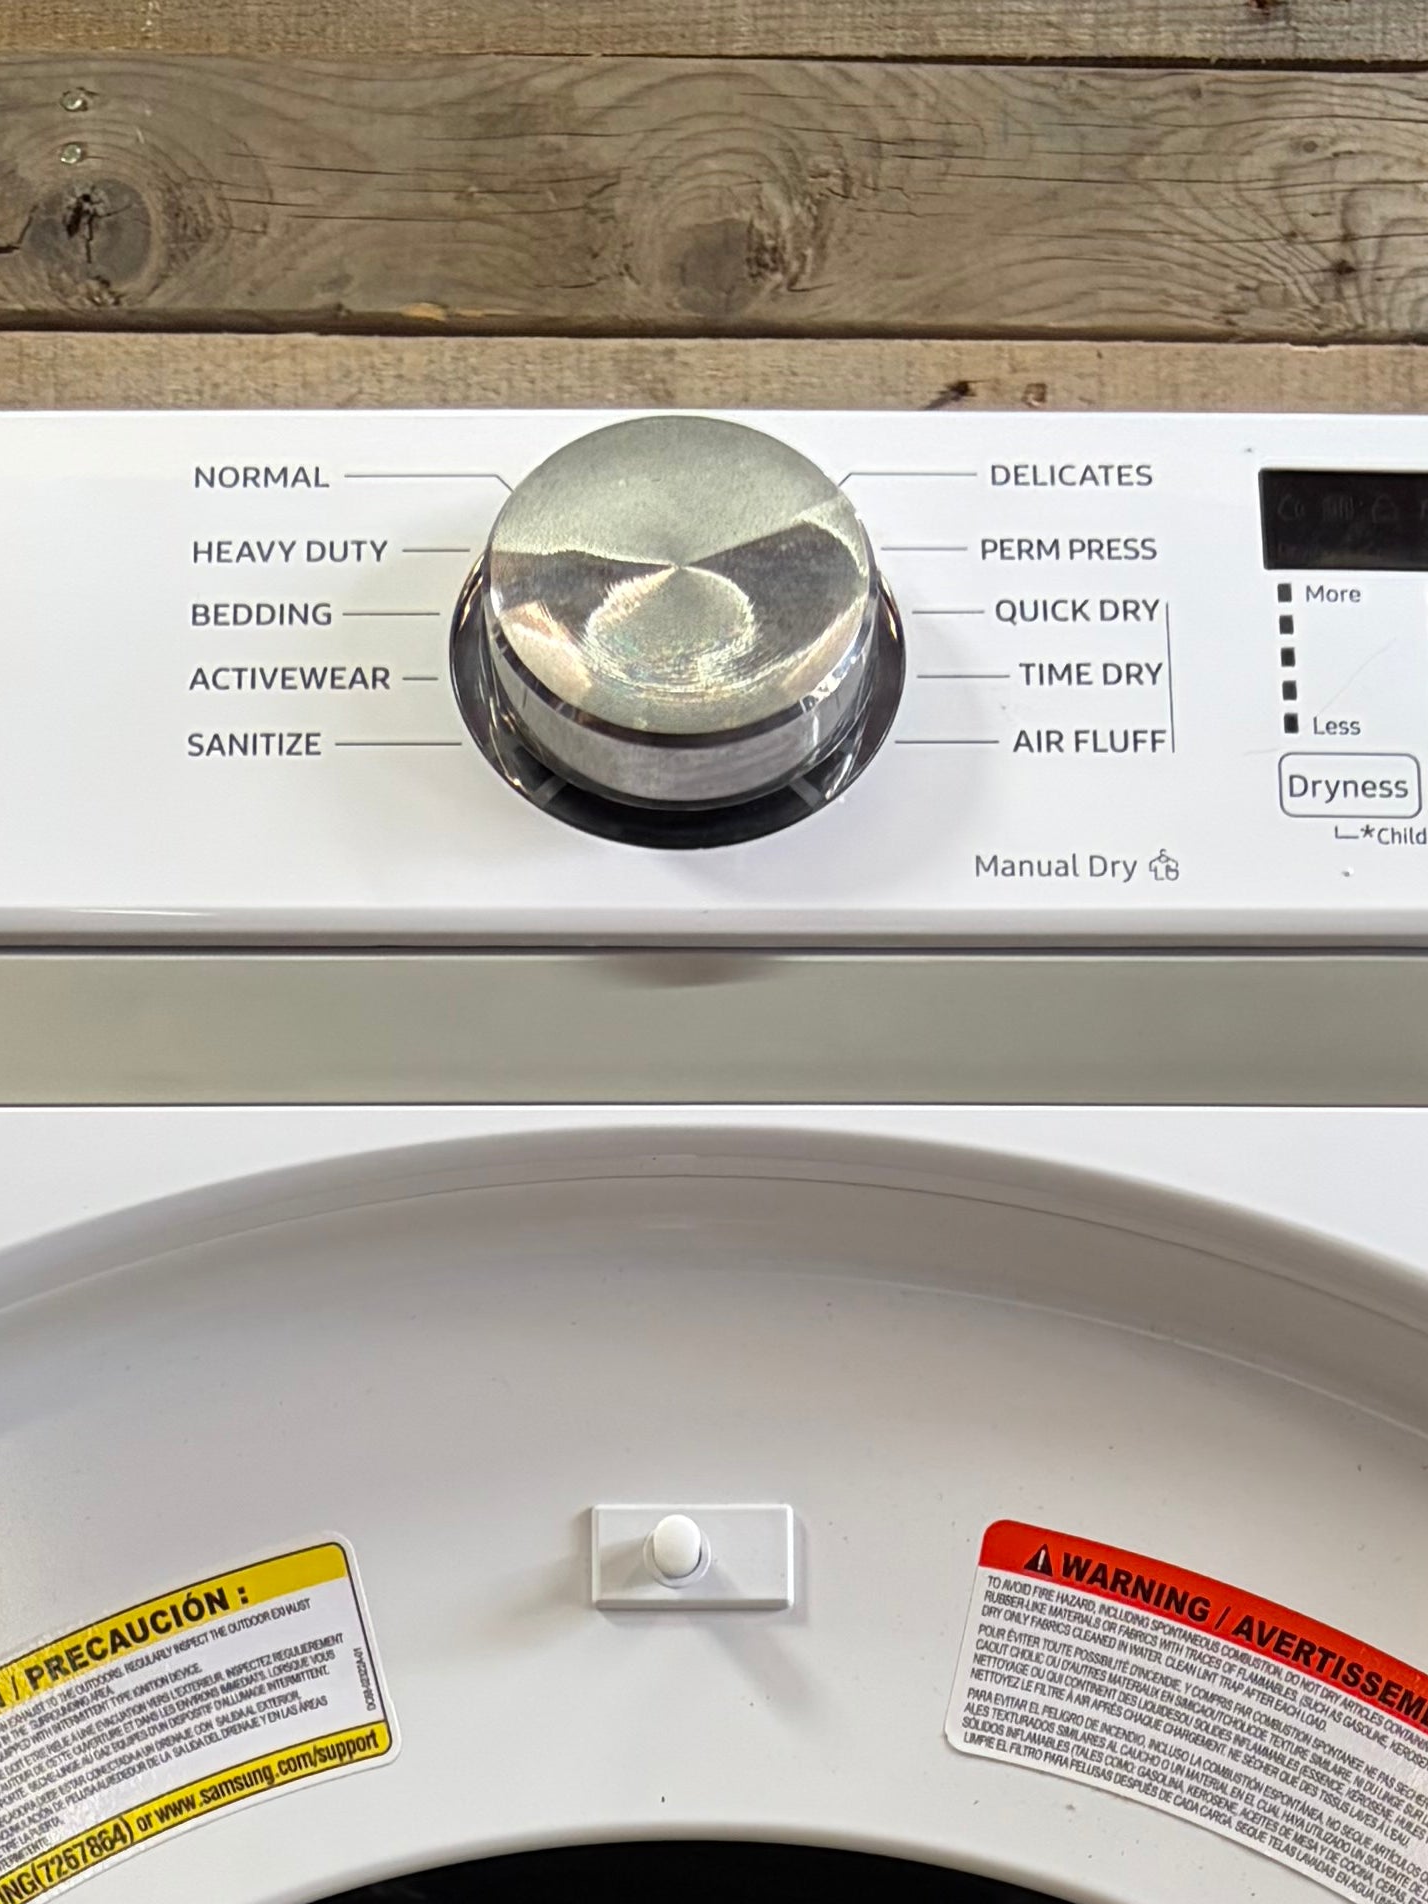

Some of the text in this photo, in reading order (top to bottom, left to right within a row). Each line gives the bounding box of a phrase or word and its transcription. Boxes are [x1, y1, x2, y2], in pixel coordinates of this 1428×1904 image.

[195, 466, 330, 488] NORMAL
[991, 464, 1153, 486] DELICATES
[194, 540, 387, 563] HEAVY DUTY
[981, 538, 1157, 560] PERM PRESS
[1306, 585, 1361, 603] More
[192, 602, 332, 626] BEDDING
[996, 599, 1160, 626] QUICK DRY
[189, 666, 390, 690] ACTIVEWEAR
[1019, 662, 1163, 686] TIME DRY
[1313, 716, 1361, 735] Less
[188, 732, 321, 757] SANITIZE
[1013, 729, 1166, 753] AIR FLUFF
[1289, 774, 1408, 804] Dryness
[976, 853, 1137, 883] Manual Dry
[1062, 1552, 1211, 1622] WARNING
[1215, 1605, 1231, 1629] /
[10, 1675, 20, 1700] /
[25, 1586, 230, 1691] PRECAUCIÓN
[172, 1631, 209, 1654] INSPECT
[209, 1623, 228, 1640] THE
[227, 1610, 272, 1634] OUTDOOR
[981, 1604, 1003, 1619] DRY
[1003, 1609, 1031, 1625] ONLY
[1029, 1615, 1071, 1636] FABRICS
[1072, 1626, 1116, 1649] CLEANED
[1117, 1640, 1128, 1654] IN
[1165, 1656, 1197, 1677] CLEAN
[1196, 1670, 1219, 1685] LINT
[1219, 1675, 1245, 1693] TRAP
[1242, 1685, 1275, 1708] AFTER
[1273, 1701, 1302, 1719] EACH
[988, 1575, 1001, 1589] TO
[1002, 1579, 1032, 1596] AVOID
[1032, 1586, 1056, 1599] FIRE
[1098, 1603, 1150, 1629] INCLUDING
[1150, 1619, 1221, 1653] SPONTANEOUS
[1284, 1671, 1301, 1685] DO
[1300, 1679, 1322, 1695] NOT
[1320, 1687, 1341, 1703] DRY
[1339, 1696, 1384, 1726] ARTICLES
[136, 1811, 153, 1832] or
[155, 1729, 379, 1823] www.samsung.com/support
